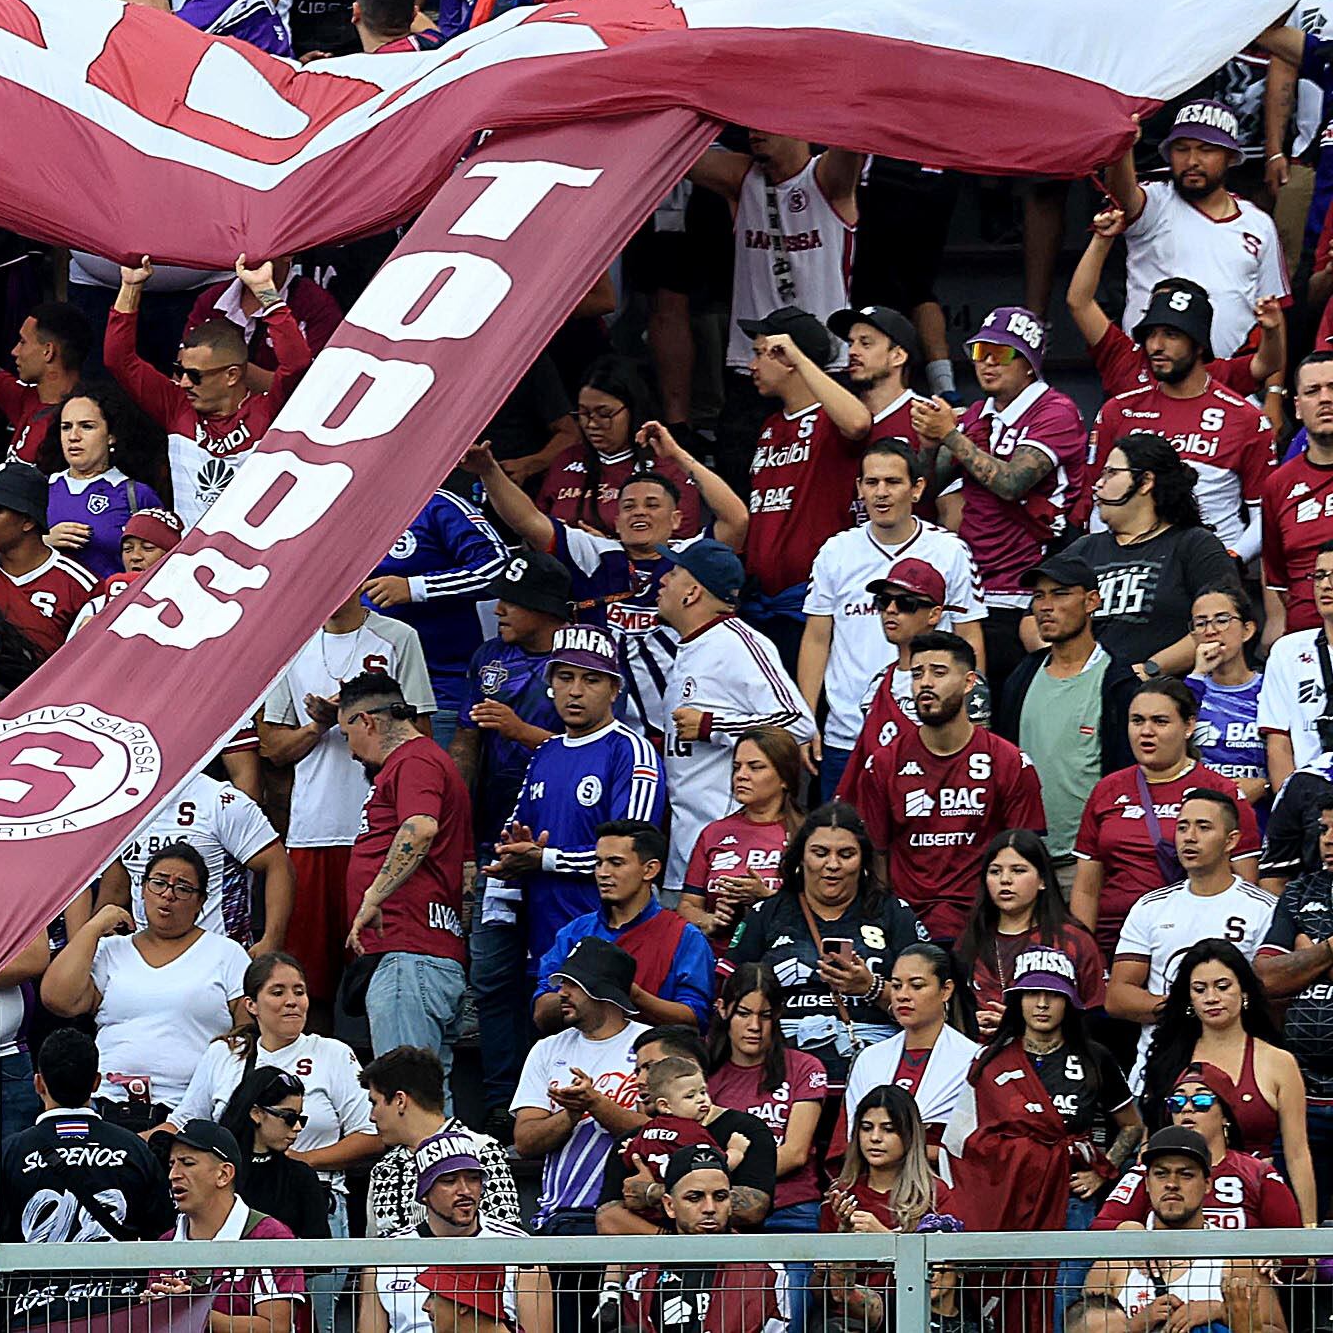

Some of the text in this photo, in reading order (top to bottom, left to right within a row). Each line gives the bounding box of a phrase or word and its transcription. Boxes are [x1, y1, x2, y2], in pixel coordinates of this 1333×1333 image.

[1008, 312, 1043, 348] 1935
[108, 159, 604, 651] TODOS
[767, 438, 811, 466] kölbi
[1171, 434, 1217, 457] ölbi
[763, 486, 794, 506] BAC
[91, 716, 155, 775] SAPRISSA
[940, 787, 986, 809] BAC
[940, 808, 984, 816] CREDOMATIC
[909, 832, 976, 847] LIBERTY
